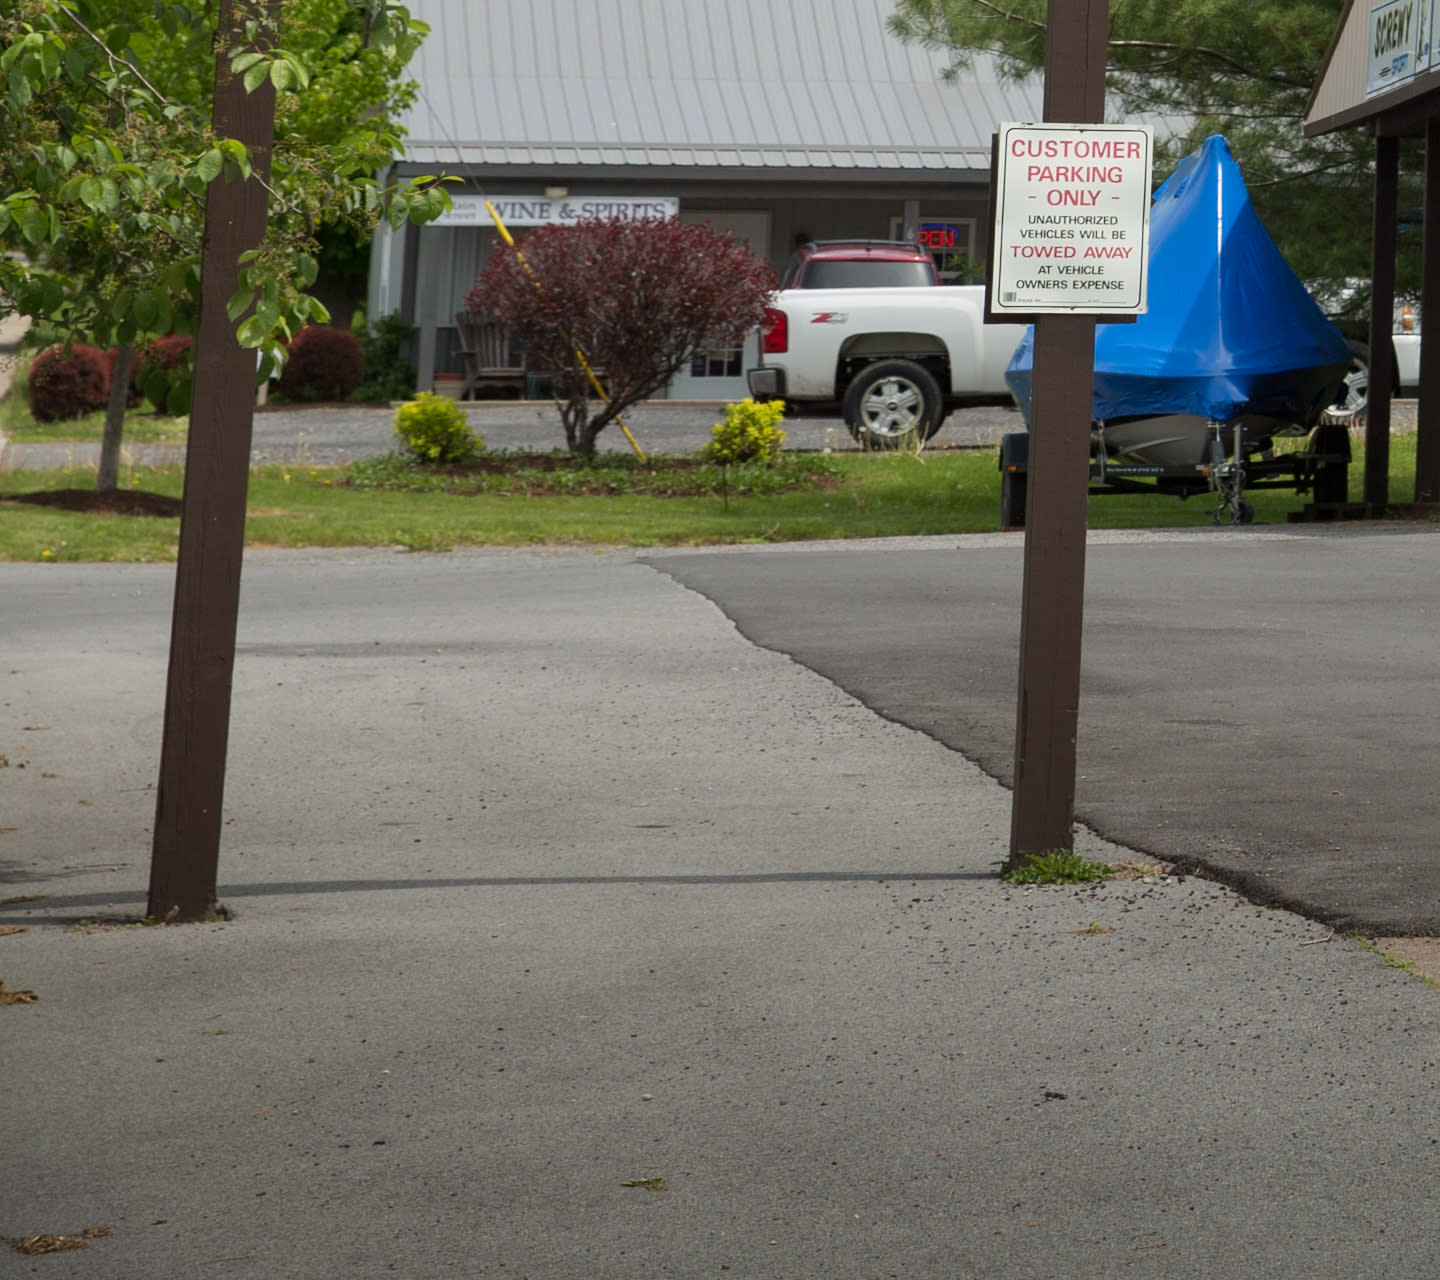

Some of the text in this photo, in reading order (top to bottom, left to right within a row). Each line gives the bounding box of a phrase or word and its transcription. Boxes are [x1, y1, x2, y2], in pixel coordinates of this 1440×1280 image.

[1375, 1, 1413, 58] SCREWY
[1011, 139, 1141, 159] CUSTOMER
[1027, 165, 1123, 183] PARKING
[1046, 189, 1102, 206] ONLY
[487, 201, 665, 219] WINE & SPIRITS
[1028, 215, 1118, 225] UNAUTHORIZED
[916, 231, 955, 249] PEN
[1020, 229, 1126, 239] VEHICLES WILL BE
[1010, 245, 1133, 259] TOWED AWAY
[1038, 265, 1104, 275] AT VEHICLE
[1016, 279, 1124, 290] OWNERS EXPENSE
